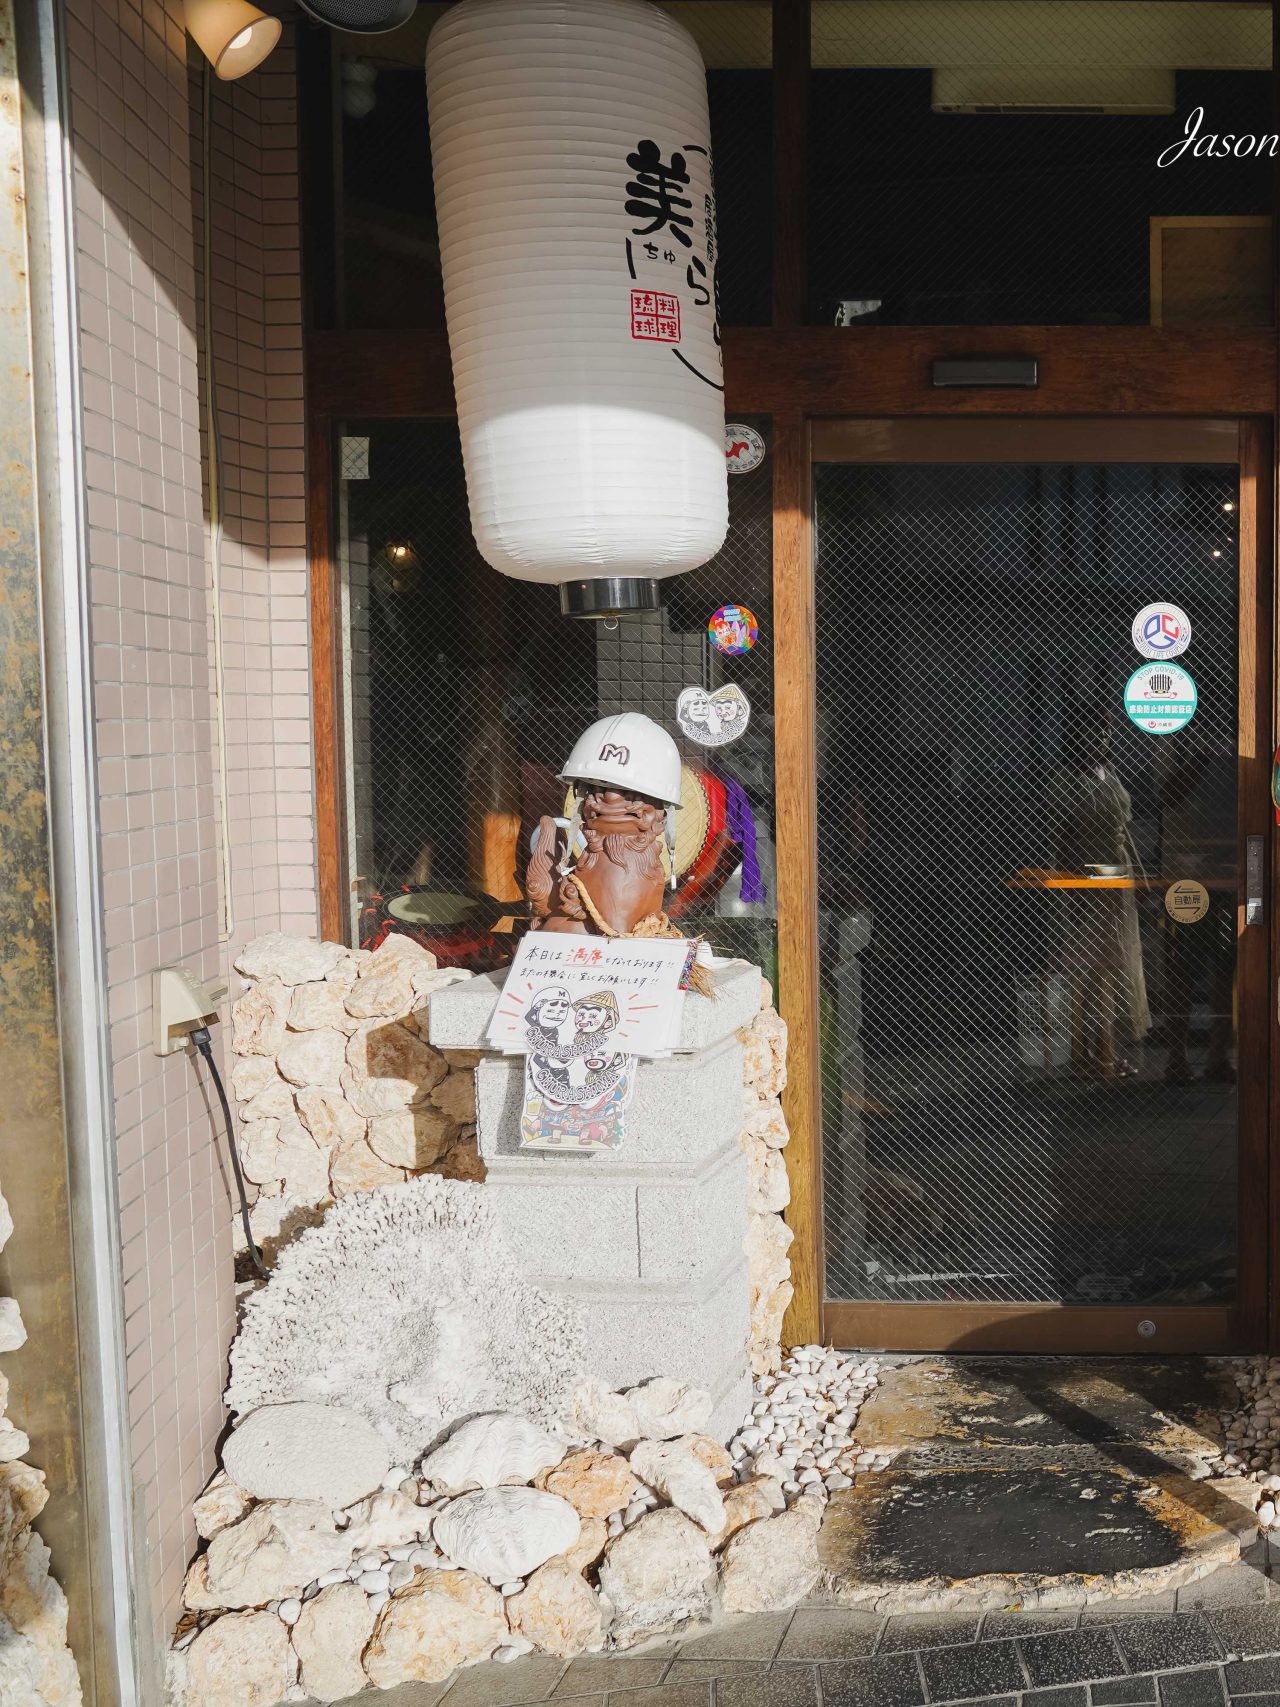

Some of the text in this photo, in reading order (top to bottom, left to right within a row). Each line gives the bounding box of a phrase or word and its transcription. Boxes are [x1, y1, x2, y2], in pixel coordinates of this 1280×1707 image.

[1137, 666, 1185, 681] STOP COVID-19
[599, 743, 630, 767] M
